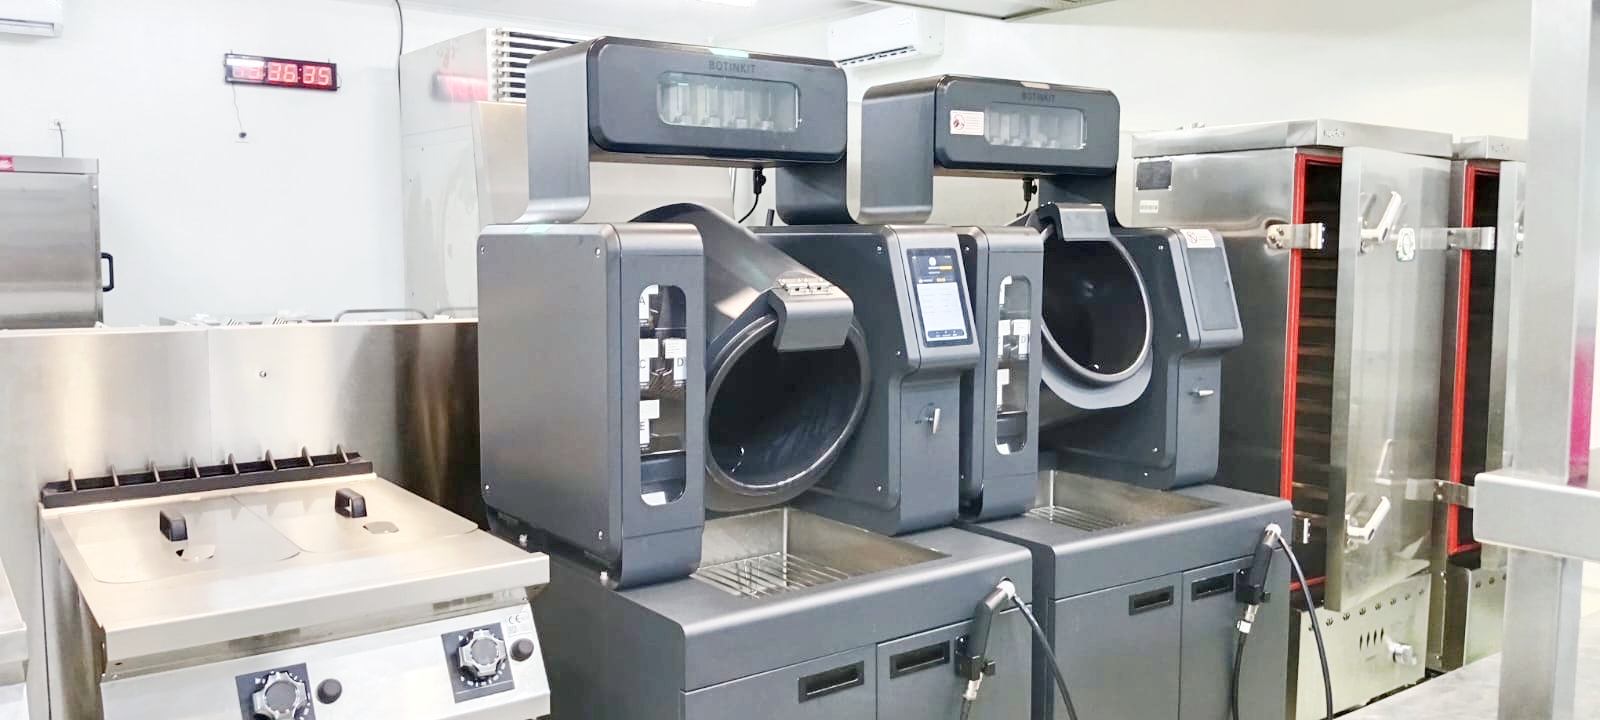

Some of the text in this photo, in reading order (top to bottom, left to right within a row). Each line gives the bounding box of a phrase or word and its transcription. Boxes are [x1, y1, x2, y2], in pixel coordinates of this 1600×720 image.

[708, 60, 757, 73] BOTINKIT
[639, 359, 647, 369] C
[676, 357, 685, 367] D
